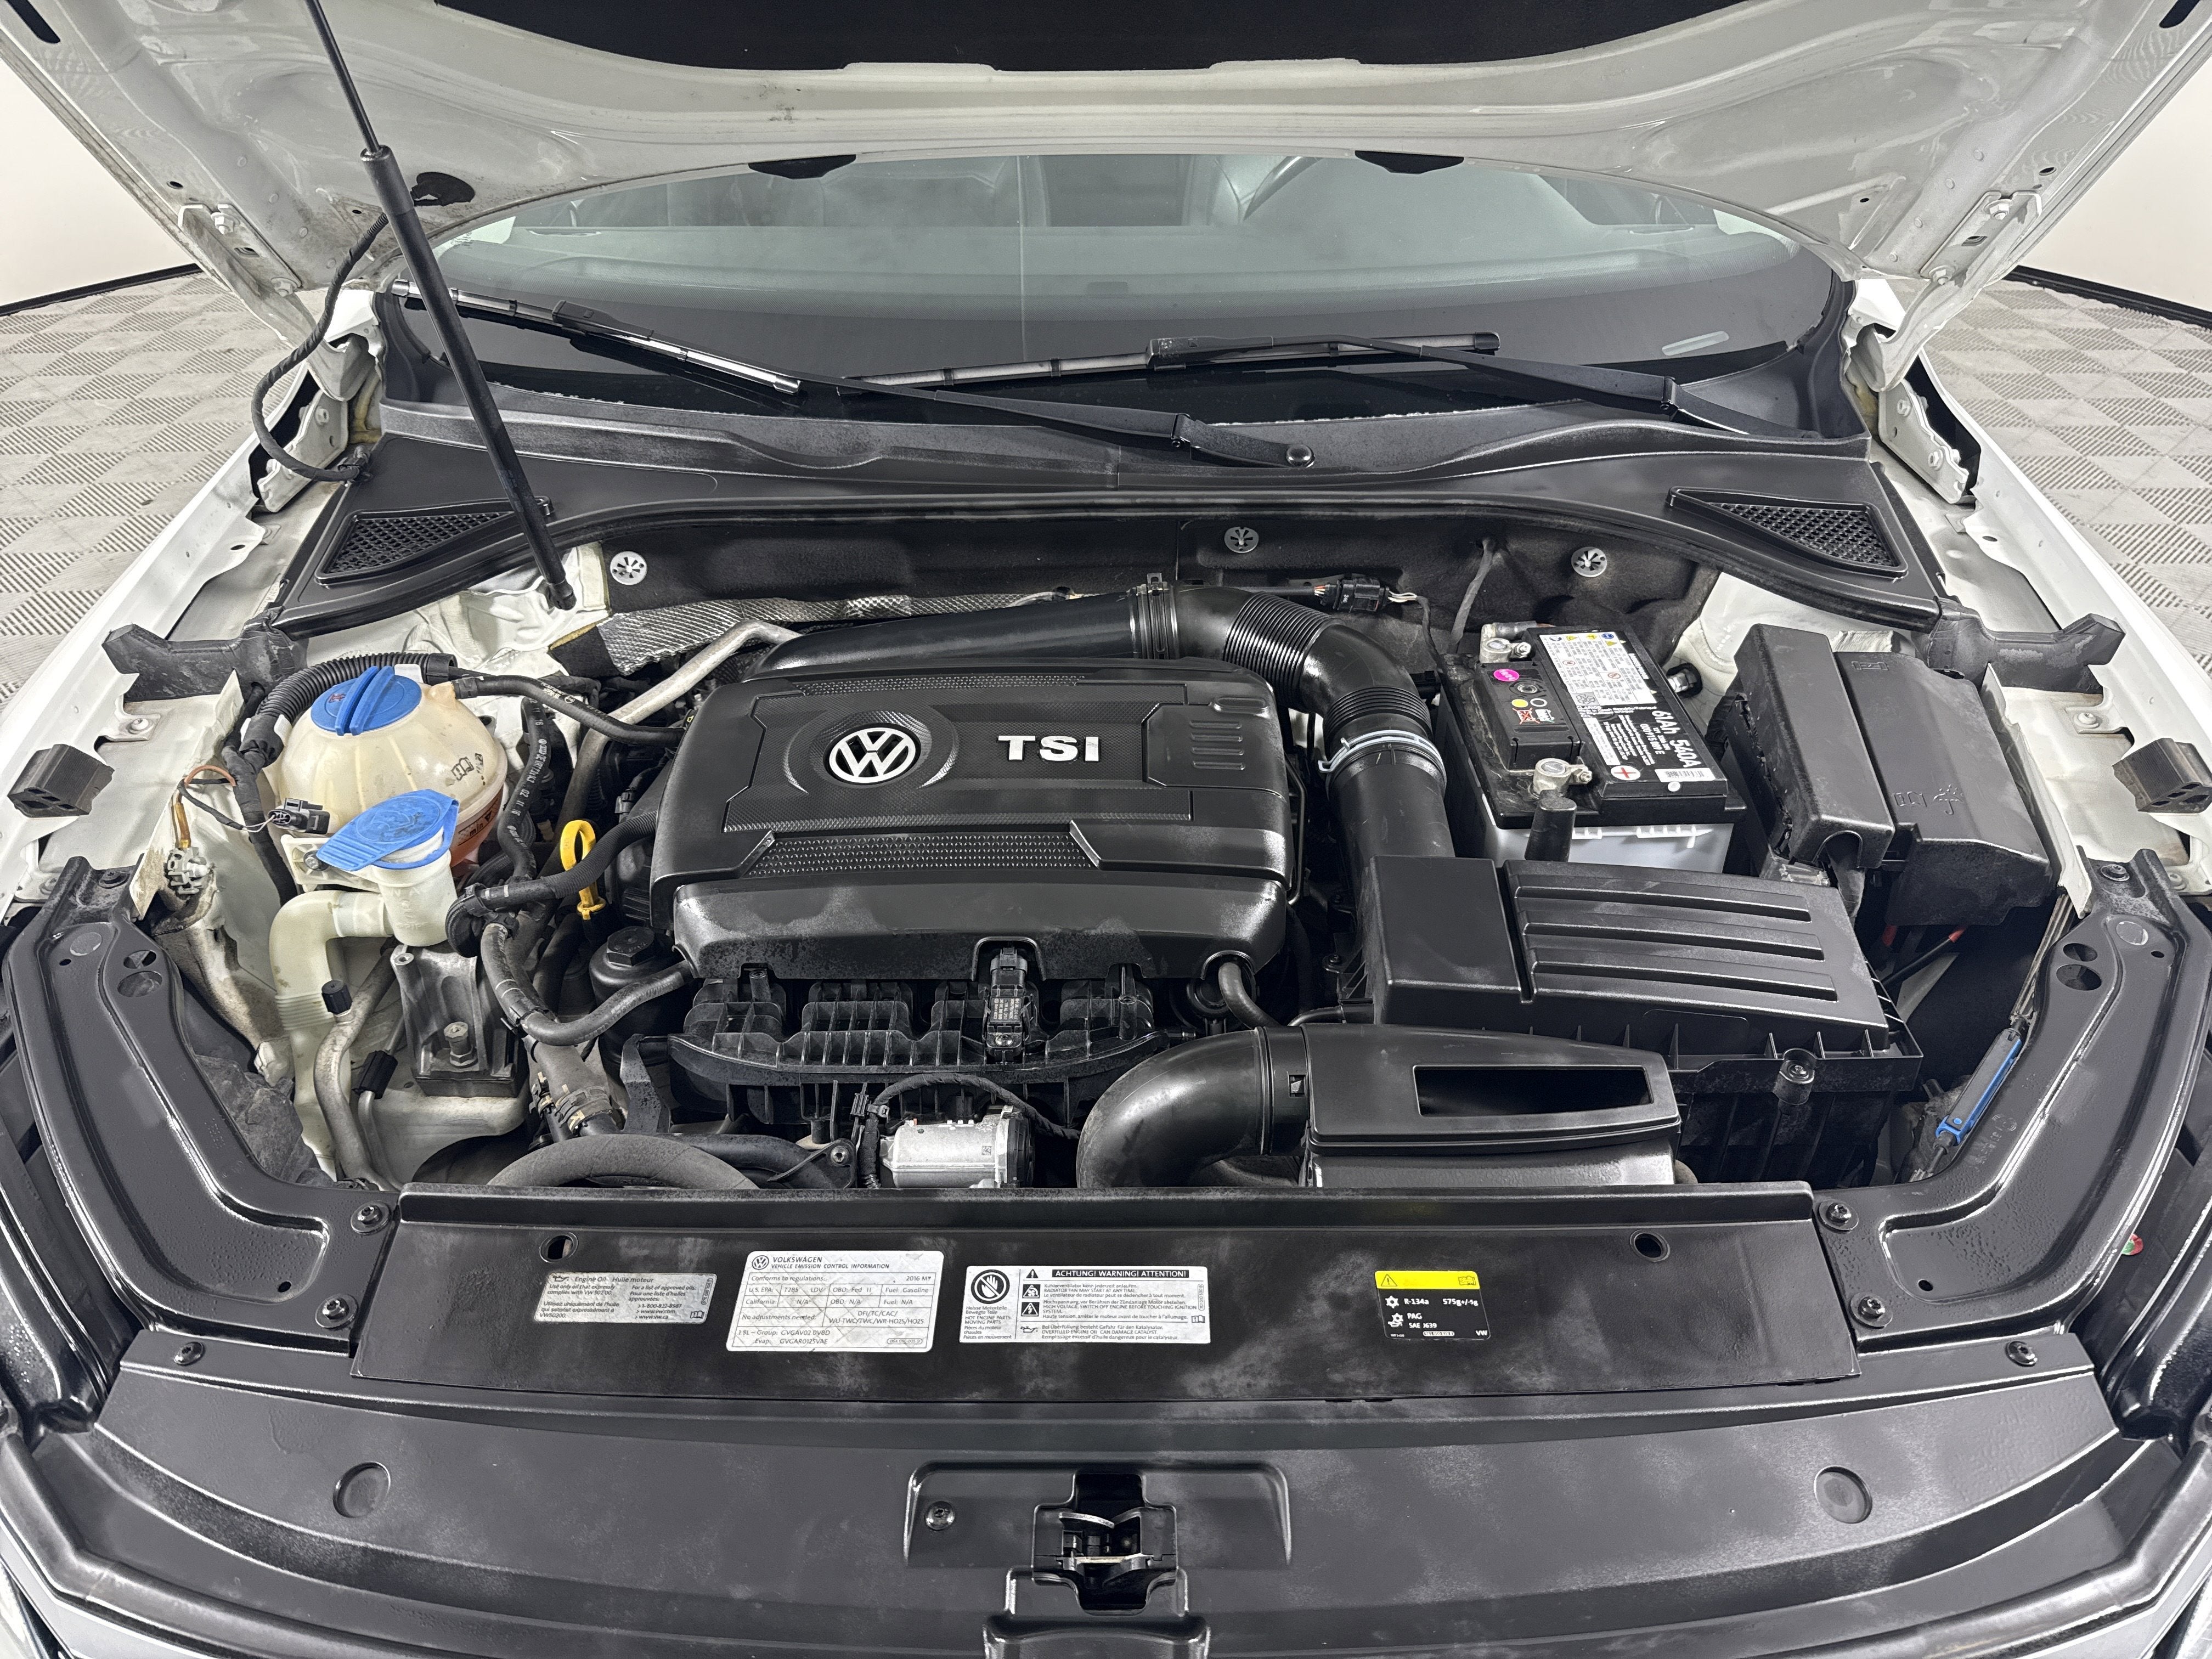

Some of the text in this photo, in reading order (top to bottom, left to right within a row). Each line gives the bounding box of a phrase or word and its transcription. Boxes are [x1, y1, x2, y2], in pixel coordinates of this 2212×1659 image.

[997, 736, 1099, 762] TSI
[1651, 710, 1701, 768] 61Ah 540A
[469, 823, 483, 837] min
